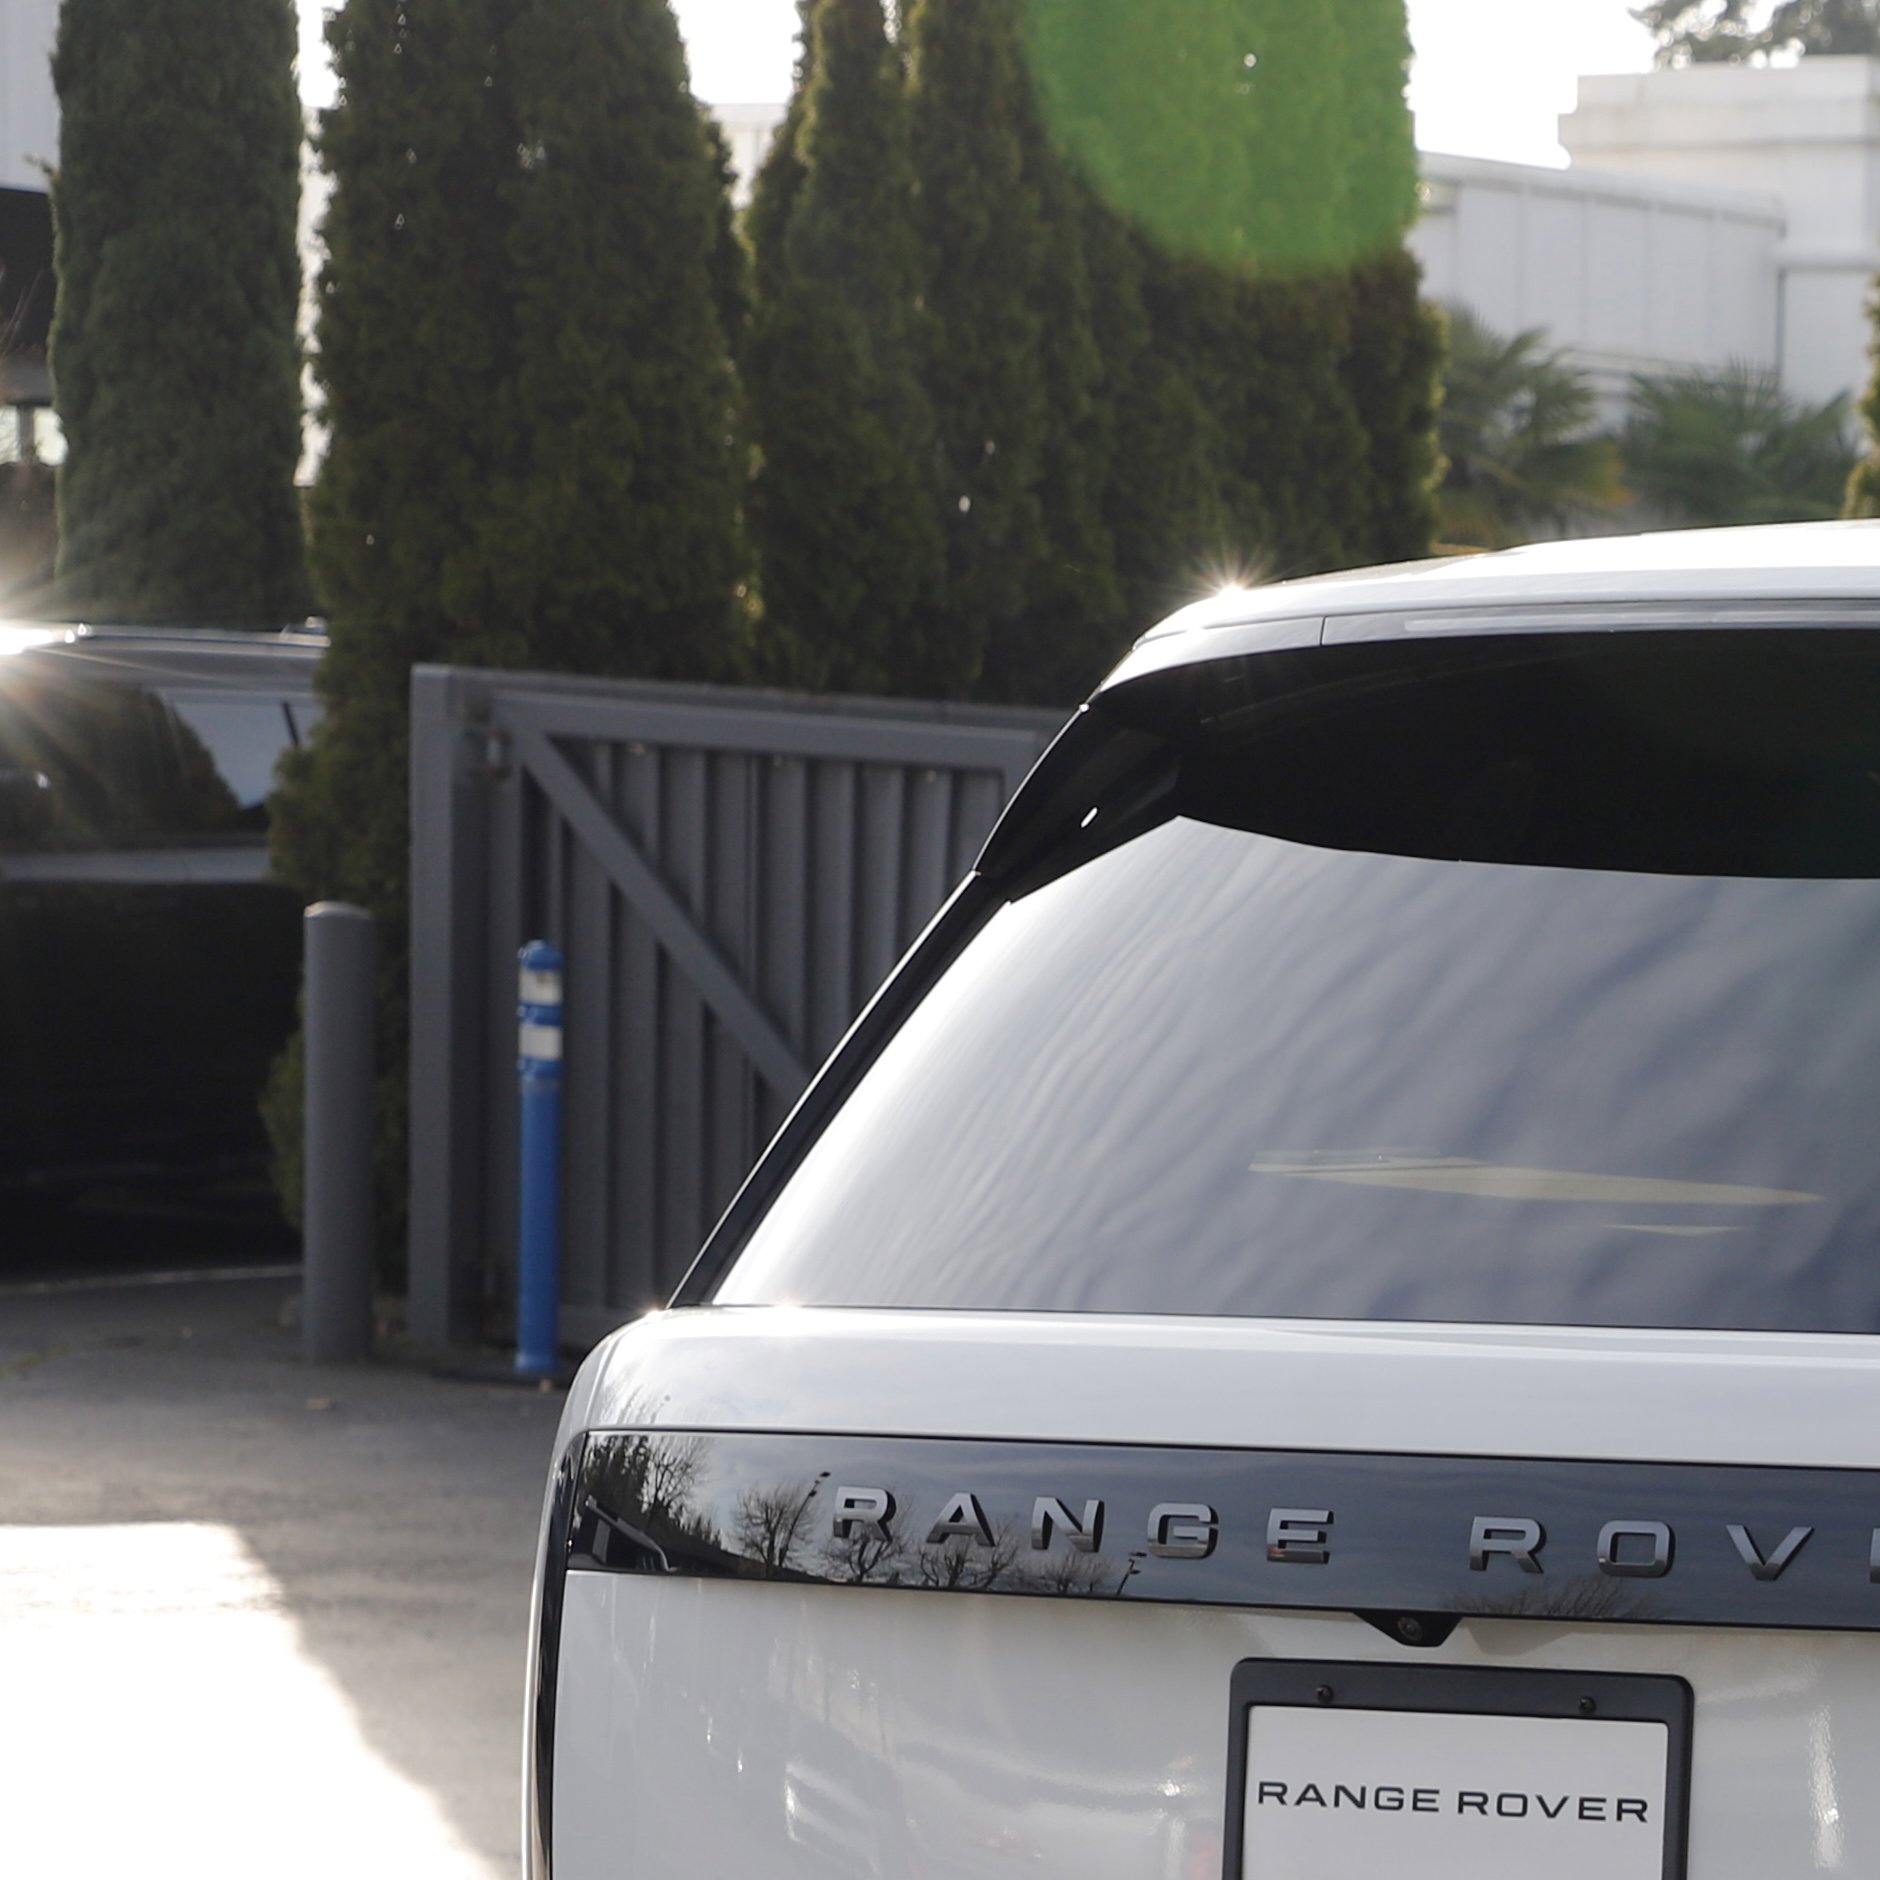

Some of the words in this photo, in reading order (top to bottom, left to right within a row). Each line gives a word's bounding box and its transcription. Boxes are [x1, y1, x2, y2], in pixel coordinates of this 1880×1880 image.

[832, 1485, 1335, 1565] RANGE
[1257, 1780, 1440, 1812] RANGE
[1457, 1791, 1648, 1823] ROVER
